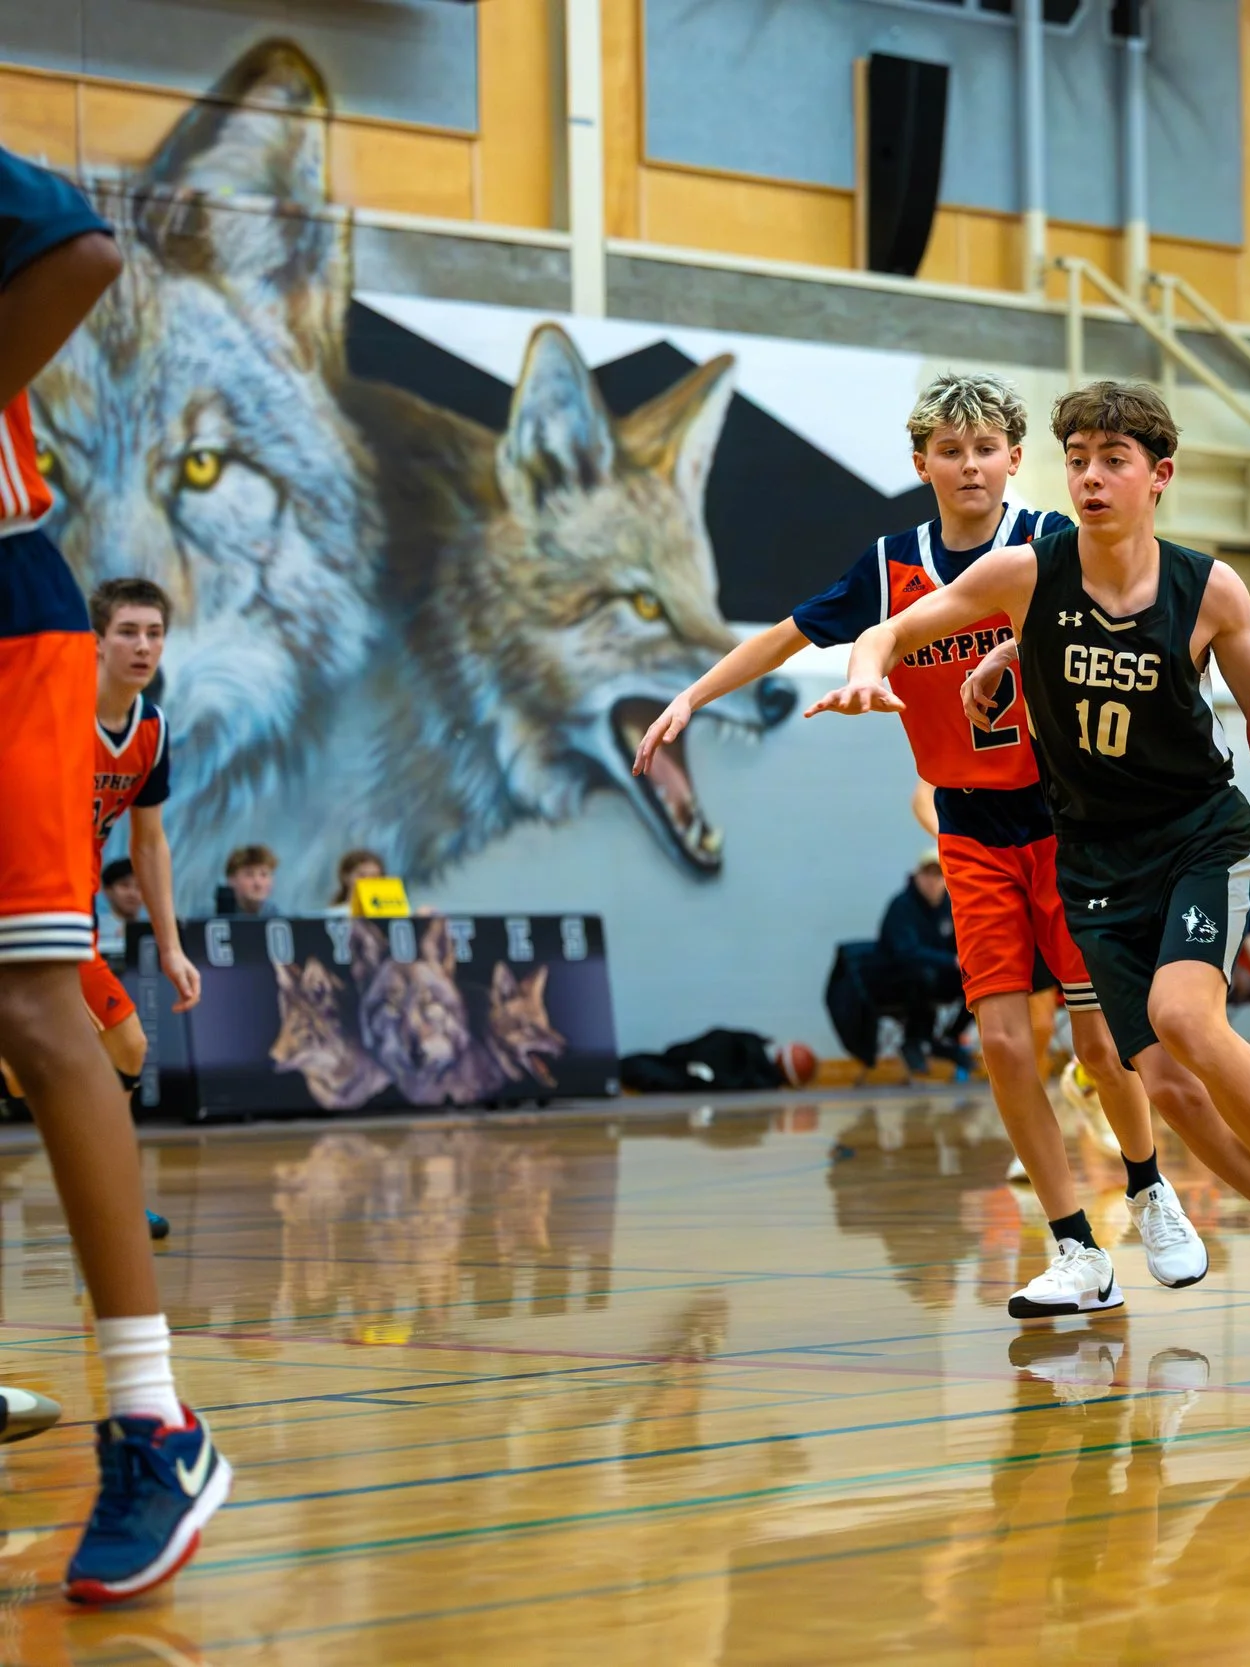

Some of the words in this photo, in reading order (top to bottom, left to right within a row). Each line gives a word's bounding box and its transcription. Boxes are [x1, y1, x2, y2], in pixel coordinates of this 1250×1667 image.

[1064, 644, 1162, 692] GESS
[965, 666, 1021, 751] 2
[1075, 698, 1131, 758] 10
[205, 915, 589, 968] COYOTES
